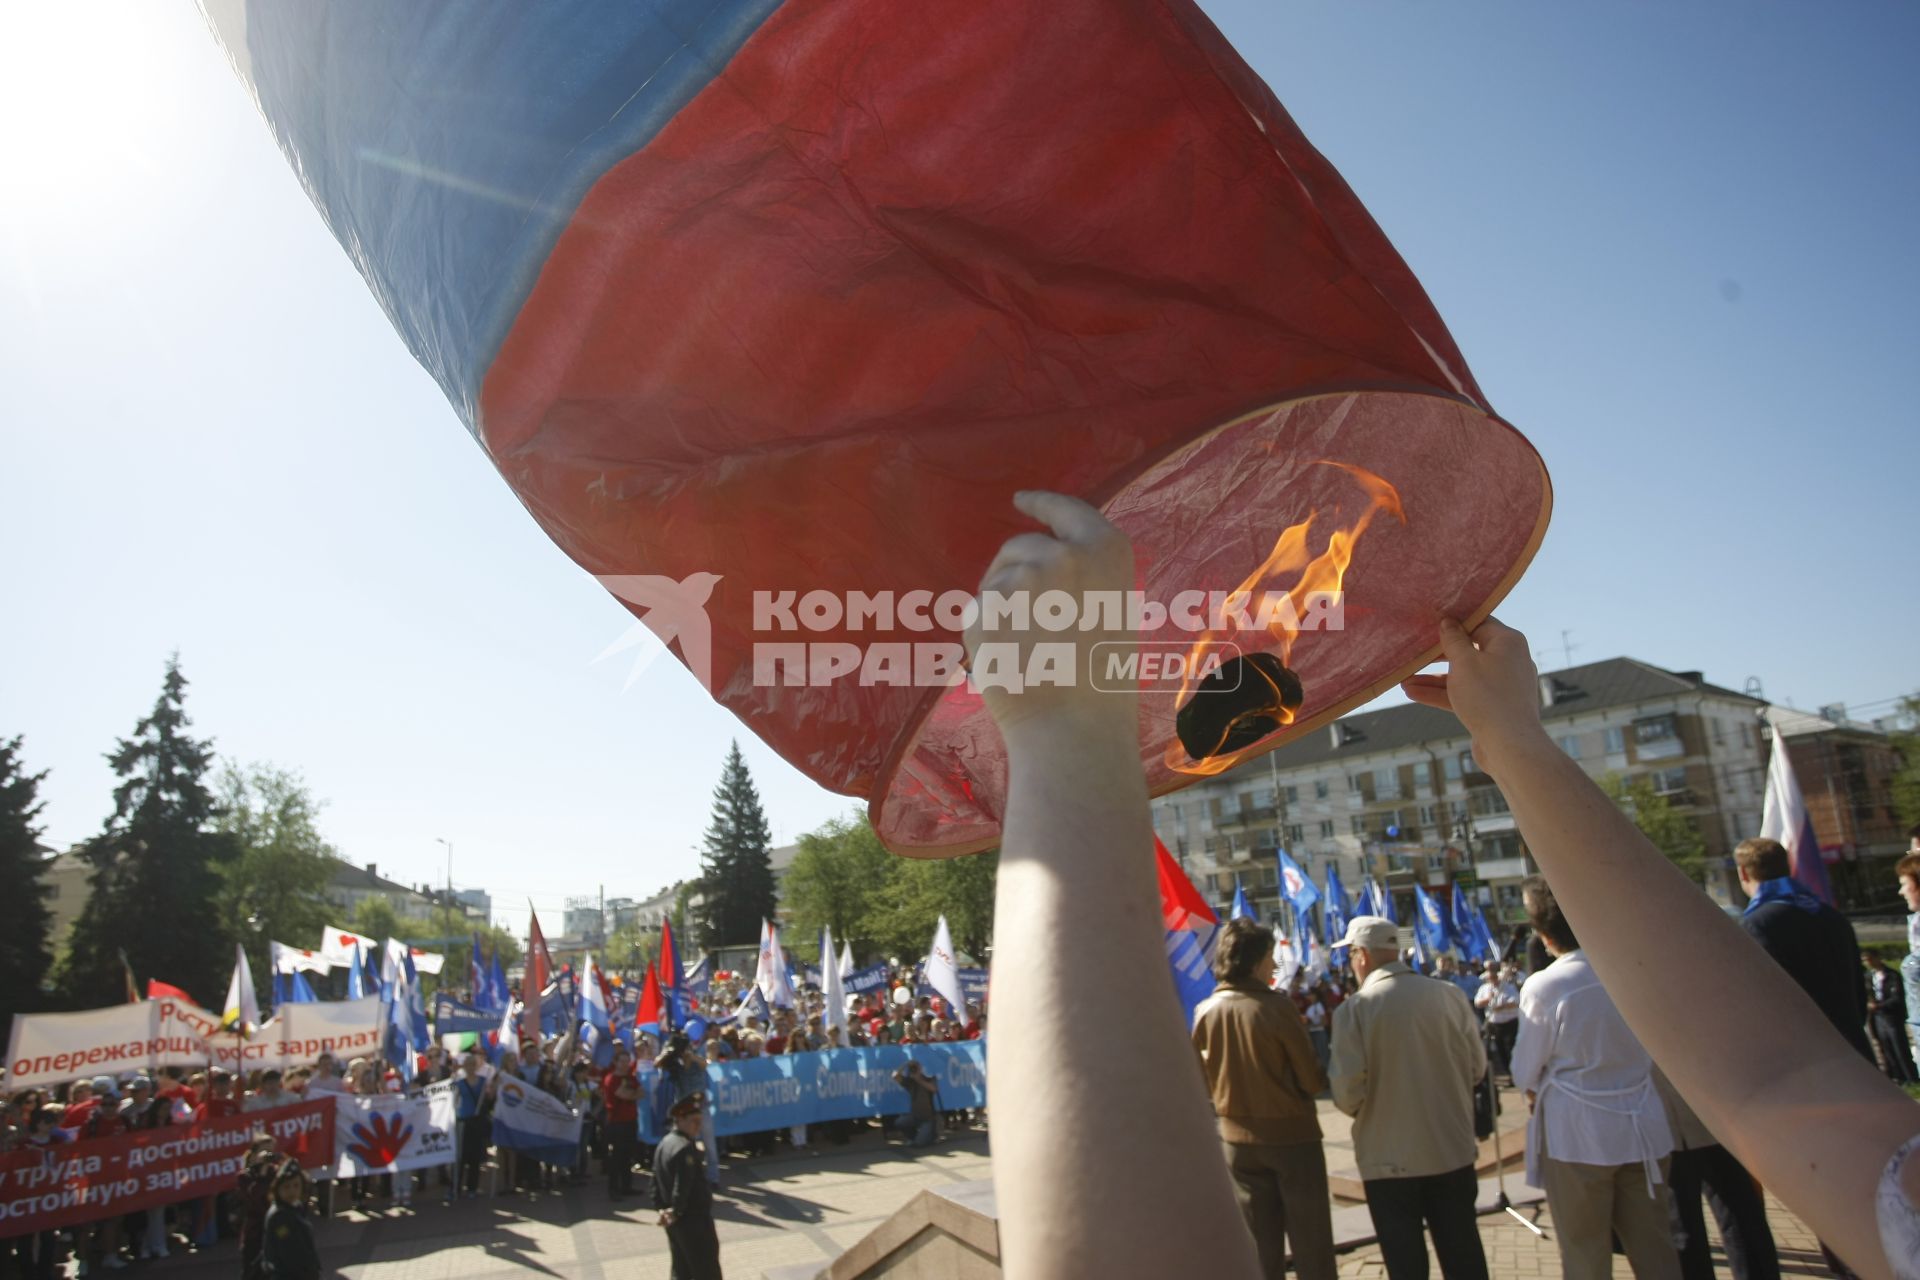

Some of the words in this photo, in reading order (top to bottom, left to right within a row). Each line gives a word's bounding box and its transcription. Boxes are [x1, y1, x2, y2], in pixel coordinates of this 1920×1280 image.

[718, 1077, 801, 1115] Единство
[15, 1154, 102, 1189] труда
[128, 1119, 266, 1169] достойный
[272, 1112, 322, 1138] труд
